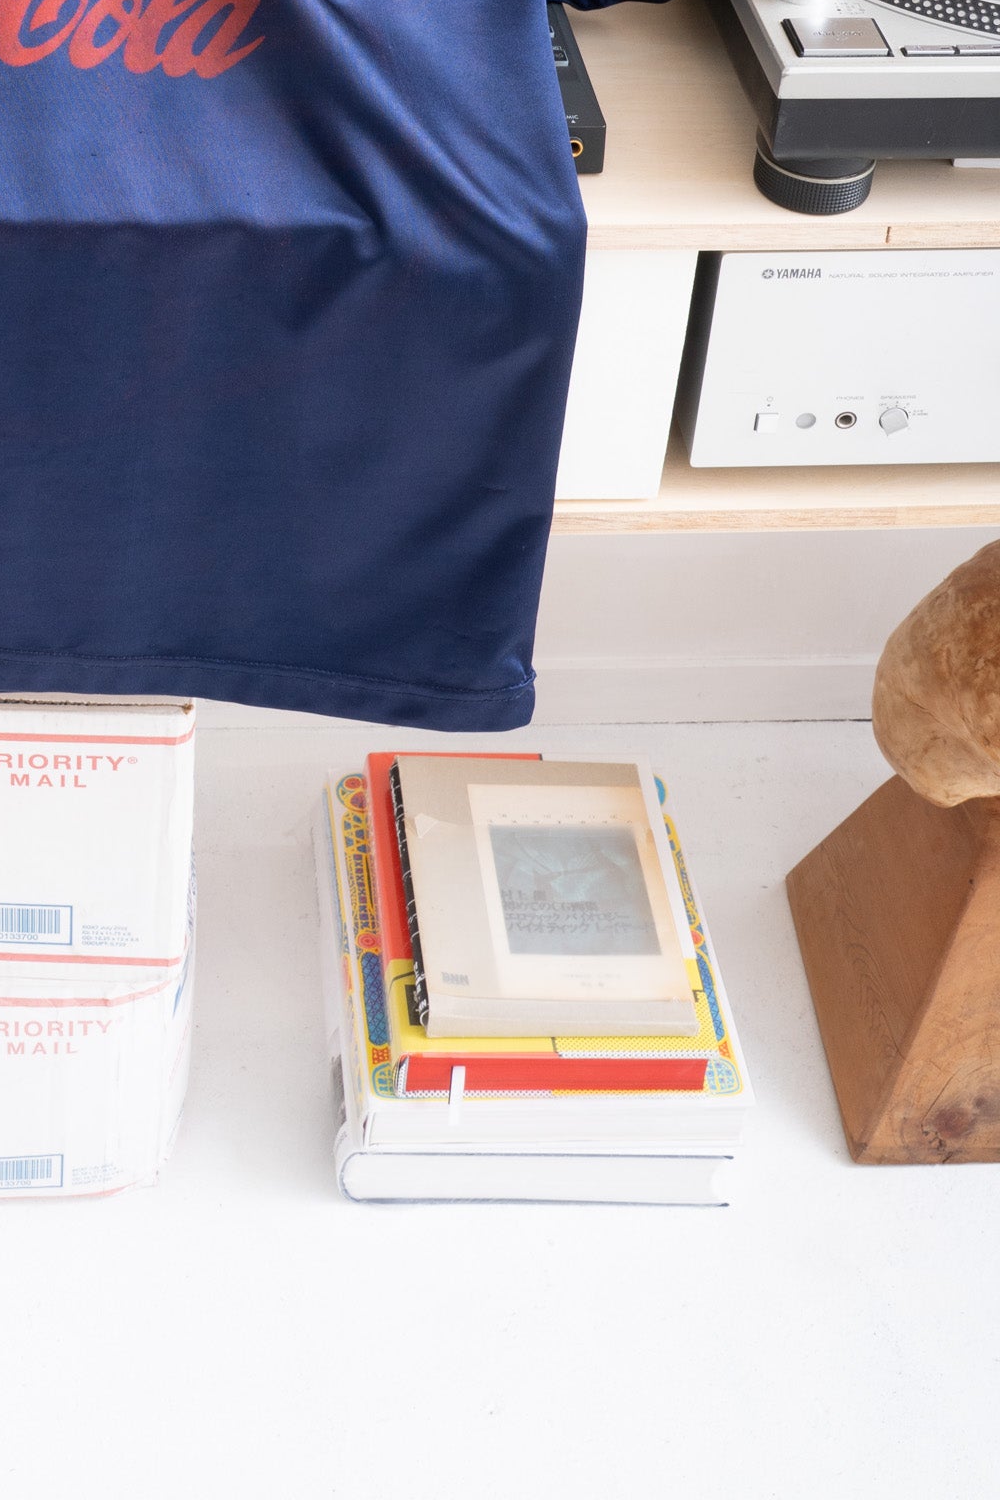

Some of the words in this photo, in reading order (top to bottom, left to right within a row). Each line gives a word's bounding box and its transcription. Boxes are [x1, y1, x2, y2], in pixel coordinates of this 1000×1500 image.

[776, 268, 822, 279] YAMAHA
[10, 773, 87, 788] MAIL
[7, 1041, 80, 1055] MAIL
